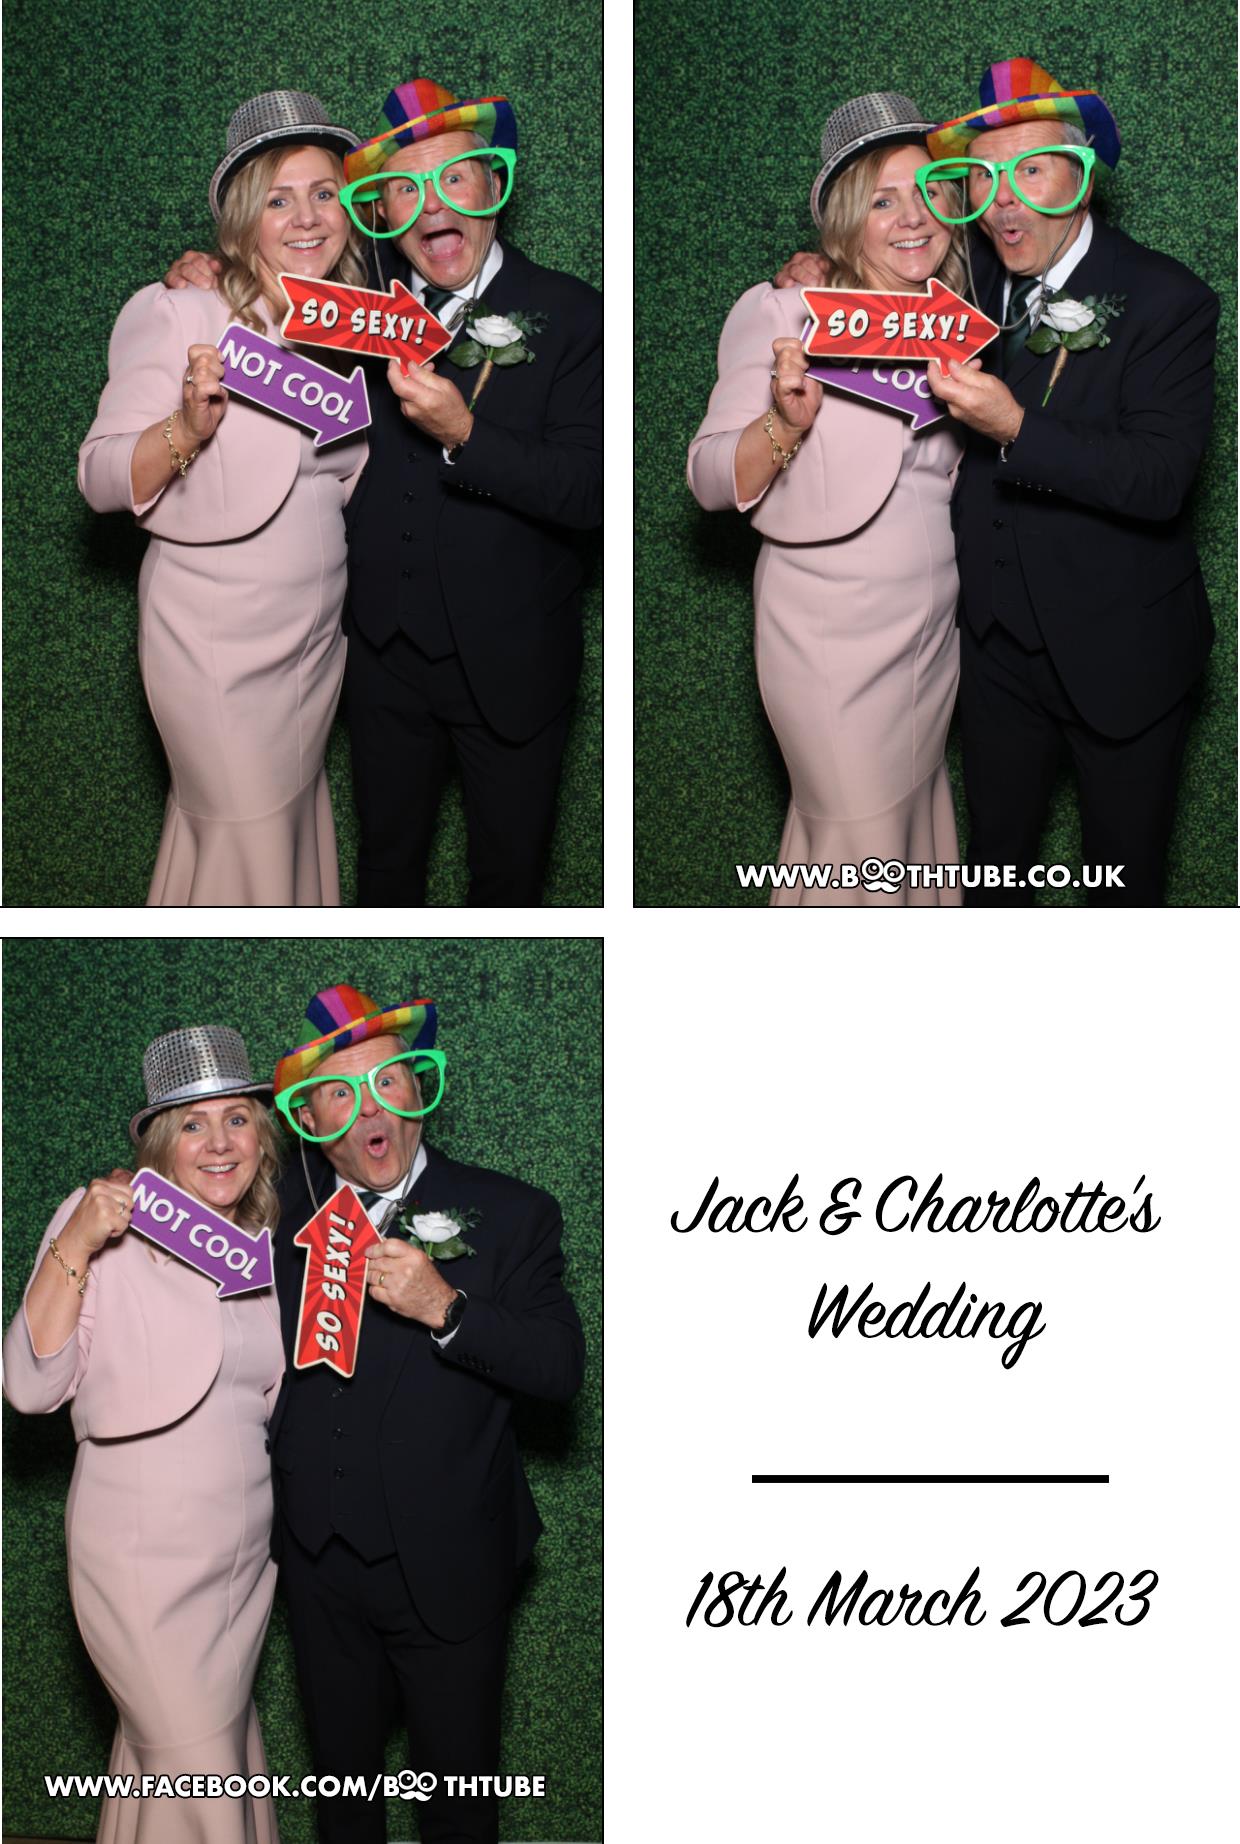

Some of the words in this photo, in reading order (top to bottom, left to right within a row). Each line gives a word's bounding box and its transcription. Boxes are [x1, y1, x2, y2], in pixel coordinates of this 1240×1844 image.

[301, 298, 339, 328] SO
[350, 307, 428, 345] SEXY!
[827, 308, 870, 338] SO
[882, 311, 970, 342] SEXY!
[221, 339, 282, 386] NOT
[282, 372, 354, 425] COOL
[133, 1183, 191, 1232] NOT
[188, 1223, 258, 1280] COOL
[321, 1211, 356, 1301] SEXY!
[315, 1311, 343, 1352] SO
